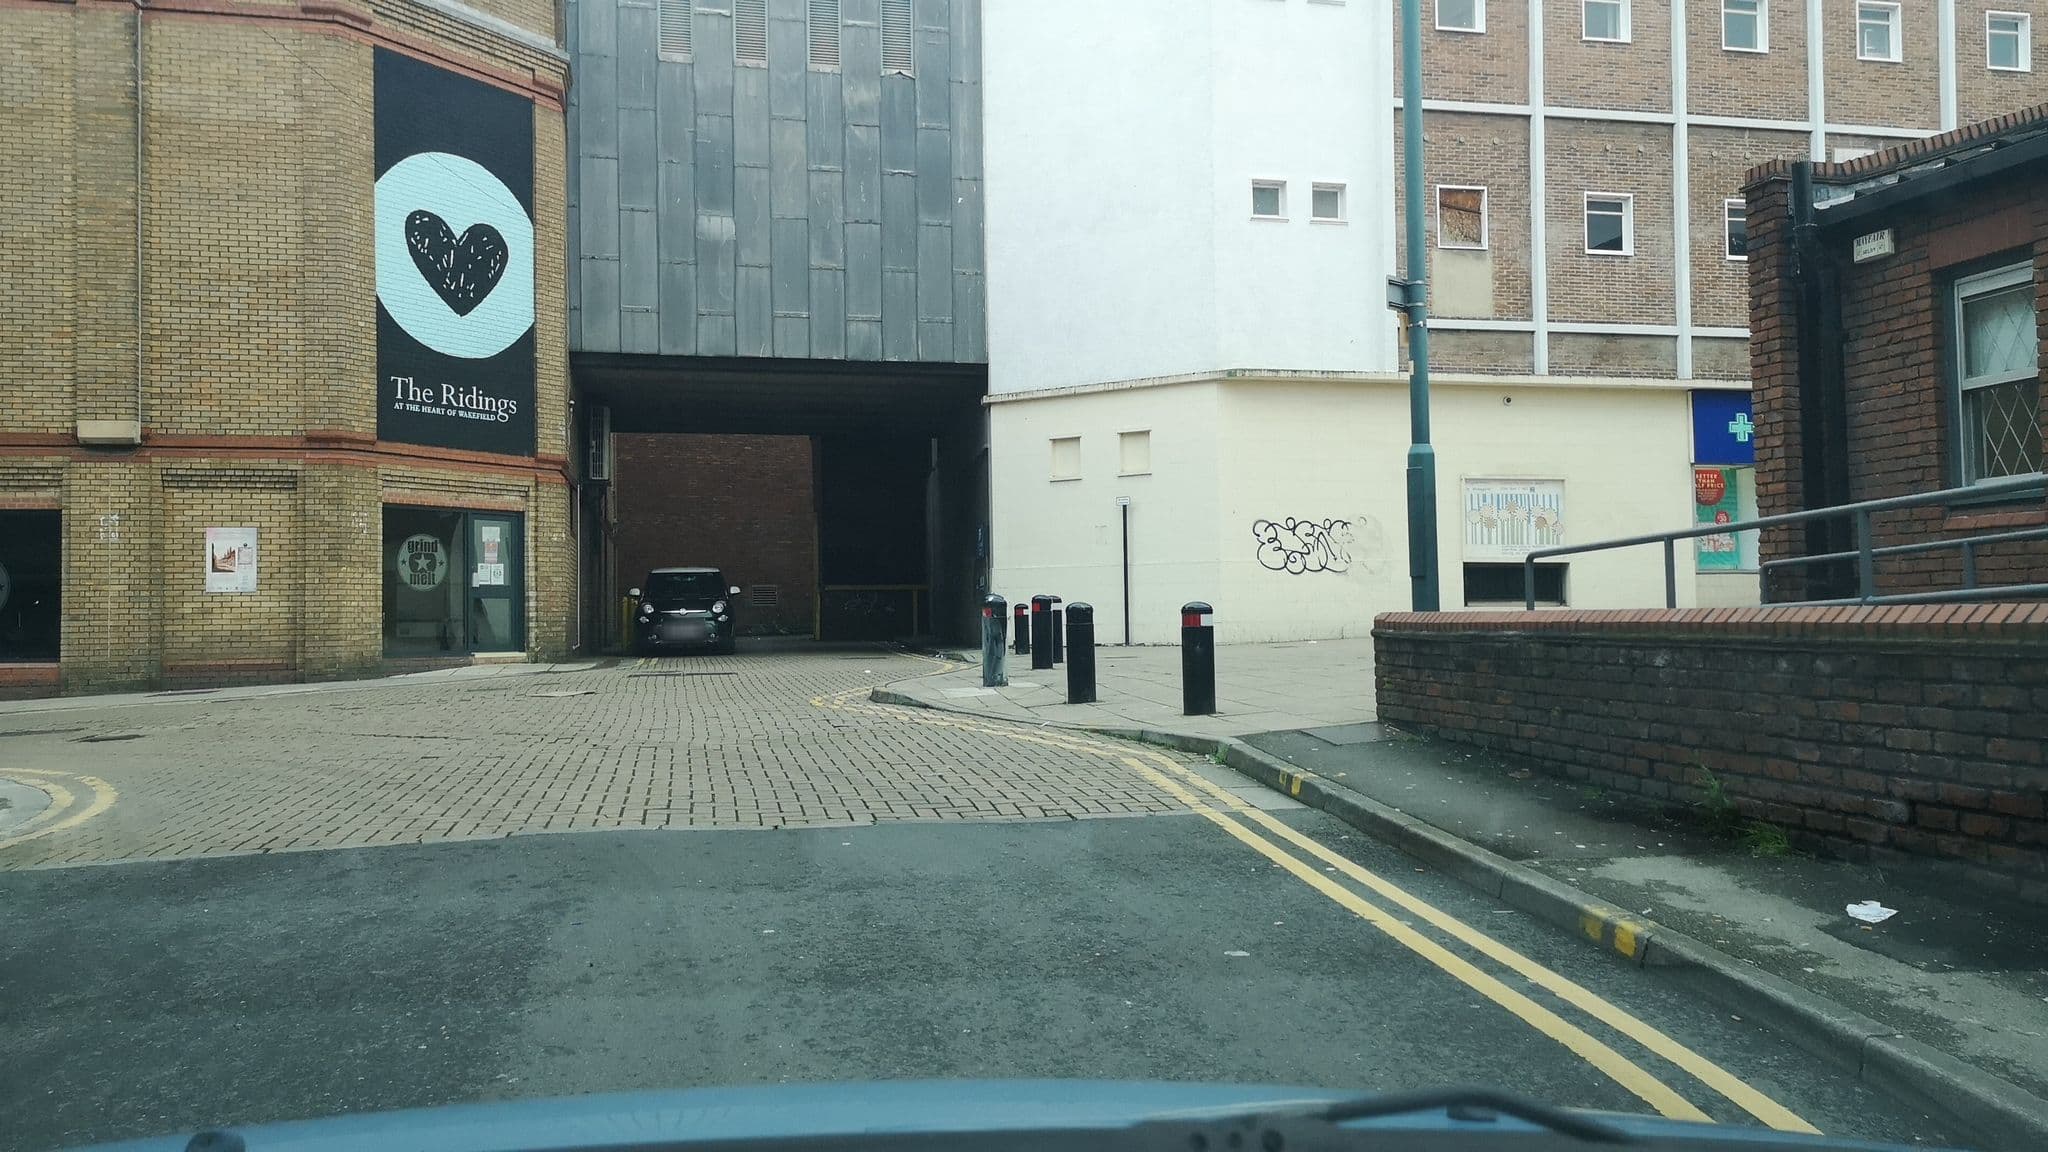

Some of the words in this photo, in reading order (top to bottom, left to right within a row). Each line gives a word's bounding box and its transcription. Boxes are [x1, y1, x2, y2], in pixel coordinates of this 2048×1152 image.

[390, 376, 434, 403] The
[441, 383, 517, 423] Ridings
[393, 402, 404, 410] AT
[405, 403, 420, 412] THE
[421, 405, 446, 415] HEART
[446, 408, 457, 417] OF
[458, 410, 496, 421] WAKEFIELD
[408, 539, 438, 553] grind
[410, 572, 435, 585] melt
